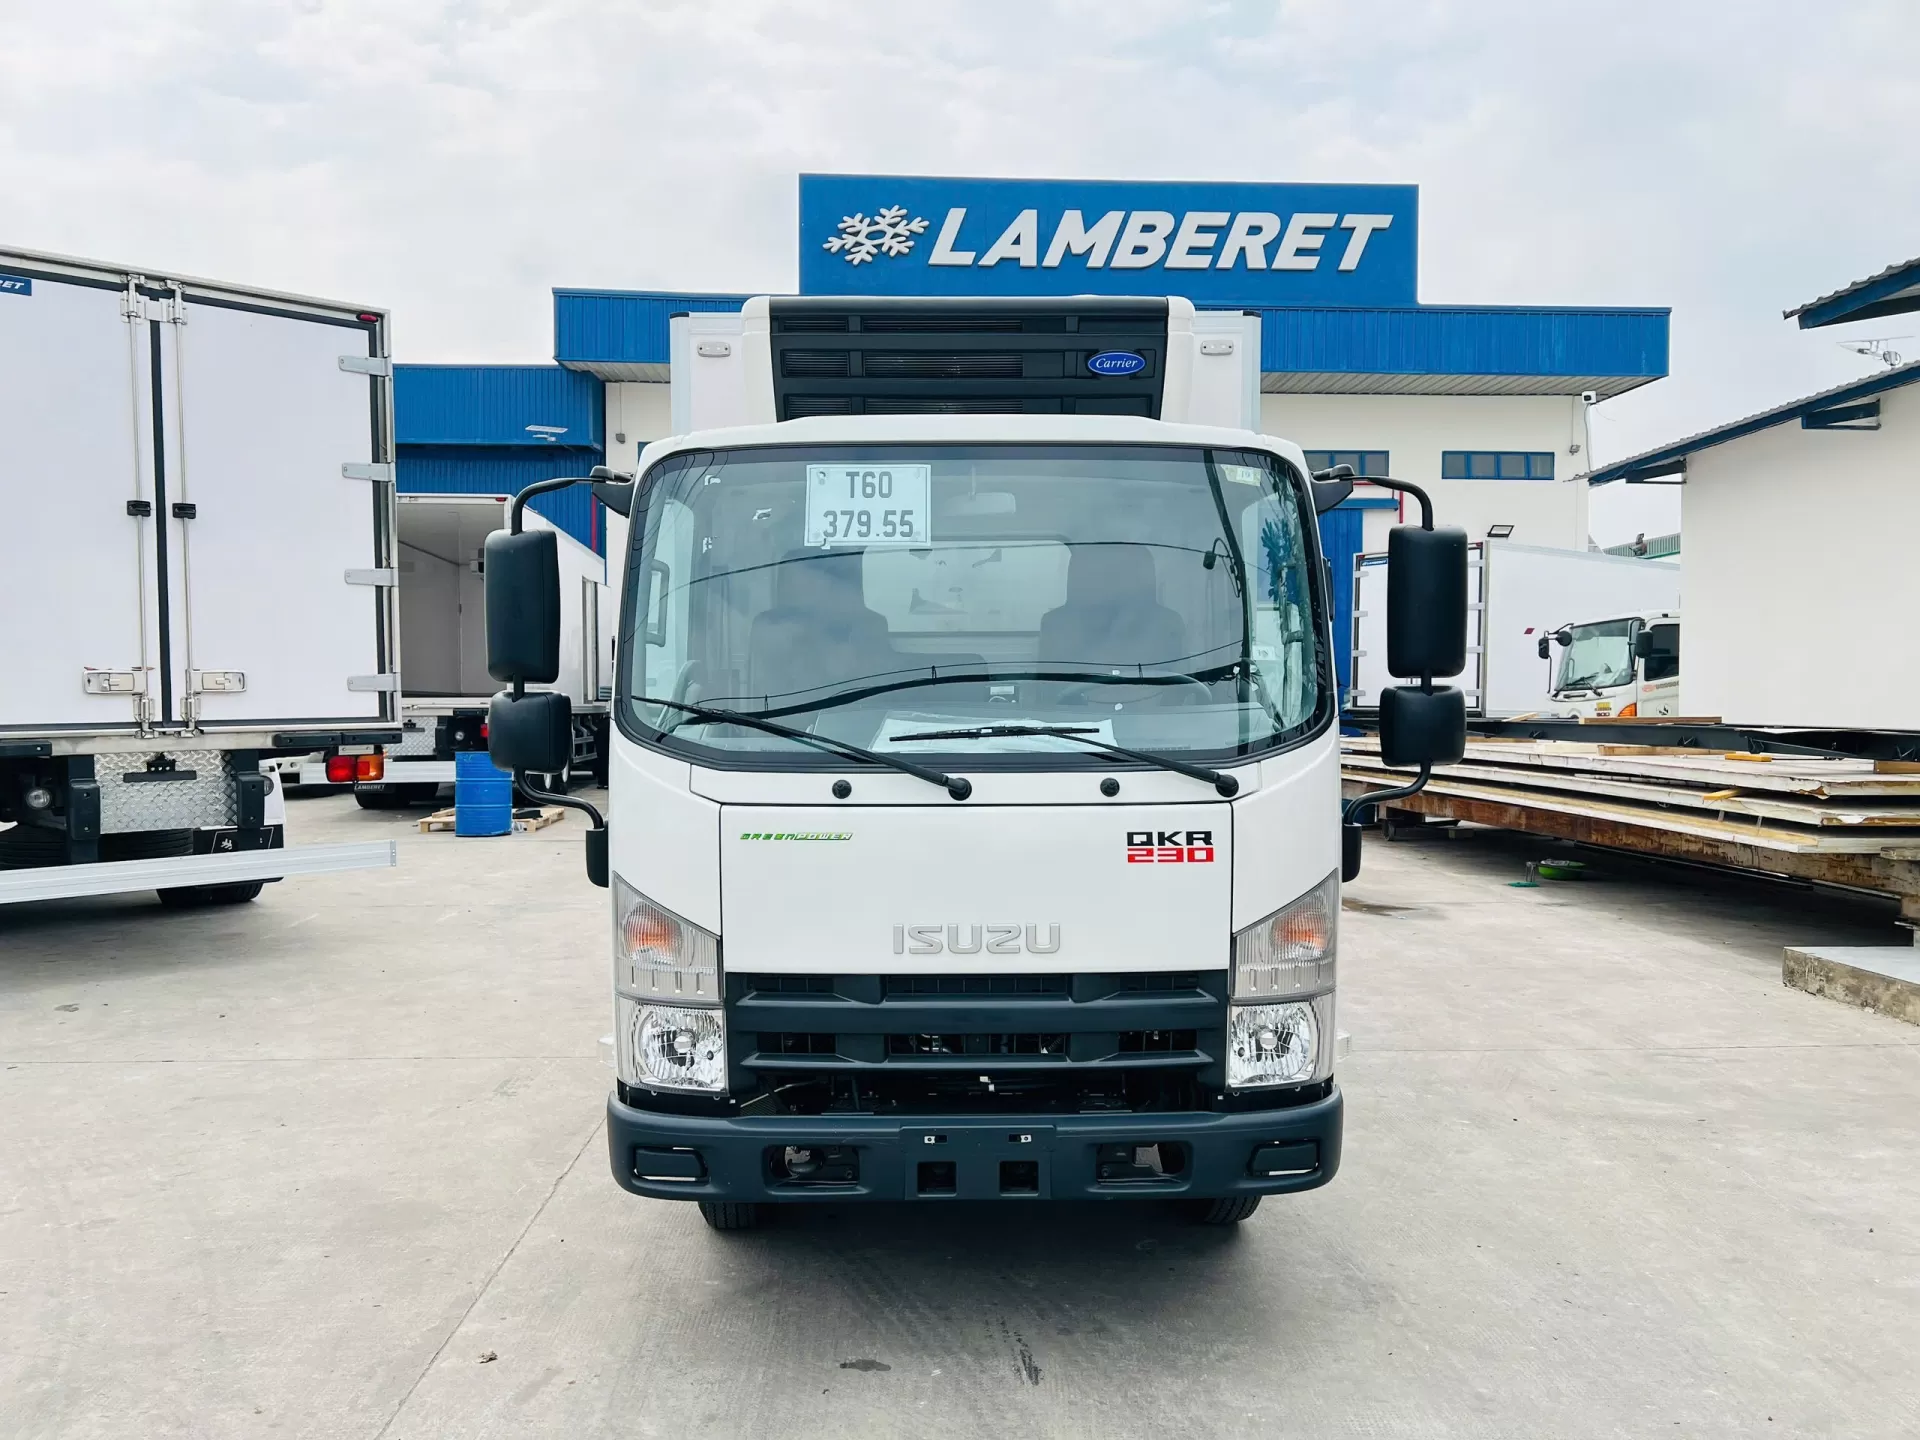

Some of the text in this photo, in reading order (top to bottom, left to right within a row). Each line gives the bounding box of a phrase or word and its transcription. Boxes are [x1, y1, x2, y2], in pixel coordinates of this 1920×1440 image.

[928, 207, 1394, 273] LAMBERET
[1096, 357, 1138, 369] Carrier
[846, 471, 893, 499] T60
[823, 509, 914, 538] 379.55
[1127, 831, 1213, 846] QKR
[1127, 847, 1214, 862] 230
[893, 923, 1061, 954] ISUZU
